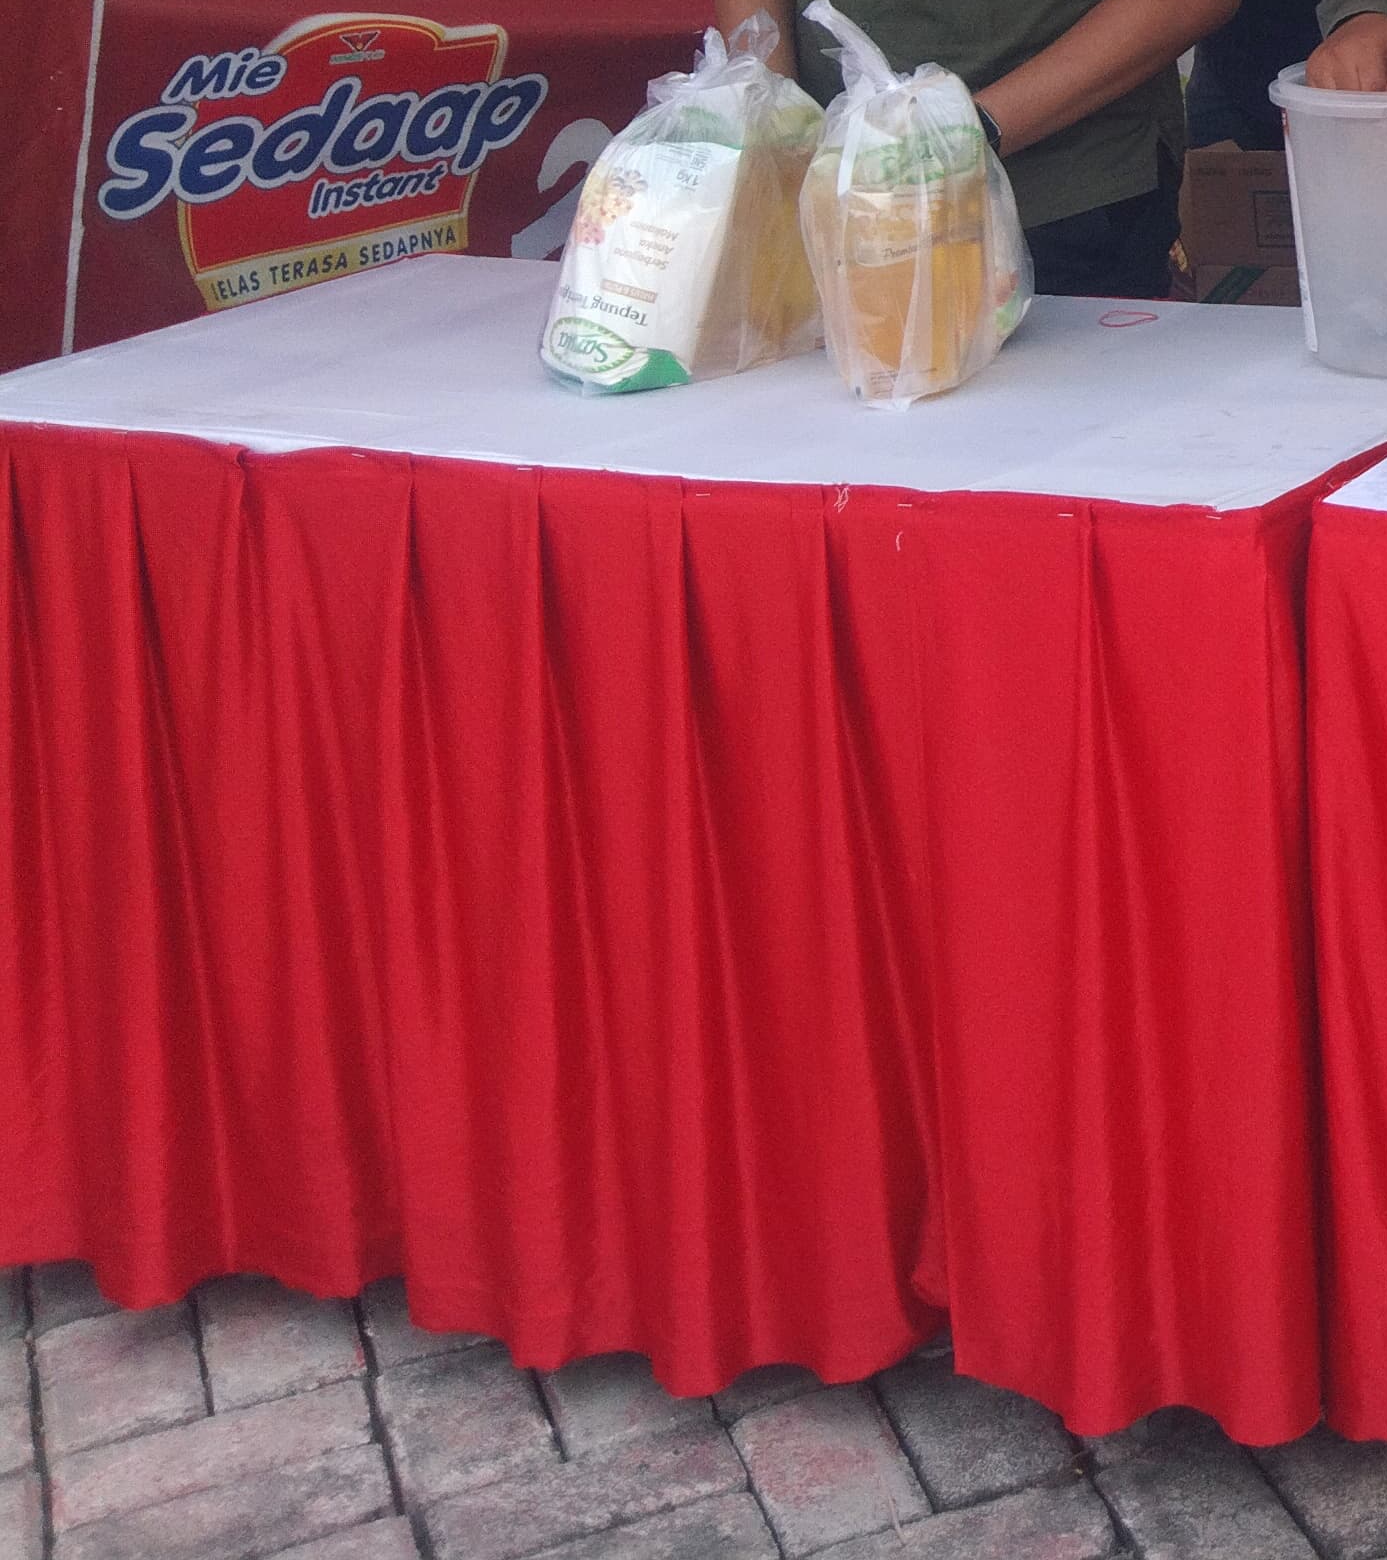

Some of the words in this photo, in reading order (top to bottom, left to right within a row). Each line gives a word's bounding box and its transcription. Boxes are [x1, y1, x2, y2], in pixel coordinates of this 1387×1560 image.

[165, 49, 286, 103] Mie
[100, 76, 547, 218] Sedaap
[309, 162, 446, 218] Instant
[269, 251, 348, 285] TERASA
[359, 224, 457, 265] SEDAPNYA
[591, 295, 649, 328] Tepung
